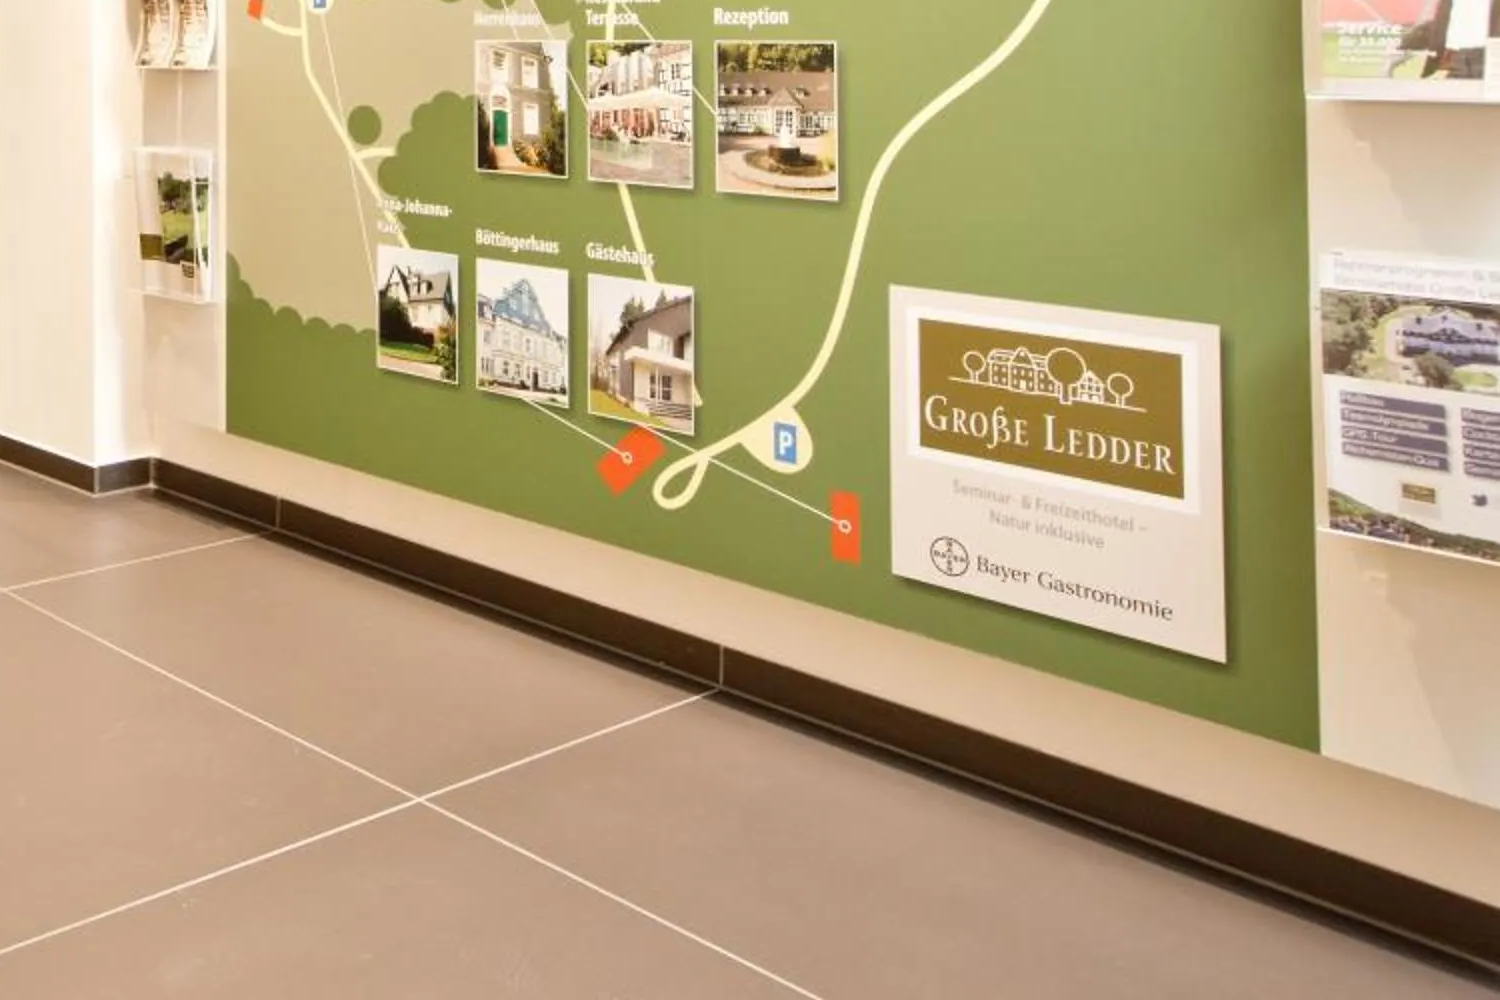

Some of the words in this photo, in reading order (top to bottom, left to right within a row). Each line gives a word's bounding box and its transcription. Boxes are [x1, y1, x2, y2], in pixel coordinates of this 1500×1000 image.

[713, 7, 789, 29] Rezeption
[476, 228, 559, 255] Böttingerhaus
[586, 241, 656, 267] Gästehaus
[778, 430, 793, 456] P
[1035, 497, 1135, 532] Freizeithotel
[989, 509, 1031, 531] Natur
[1035, 518, 1105, 549] inklusive
[976, 553, 1031, 584] Bayer
[1037, 570, 1173, 621] Gastronomie
